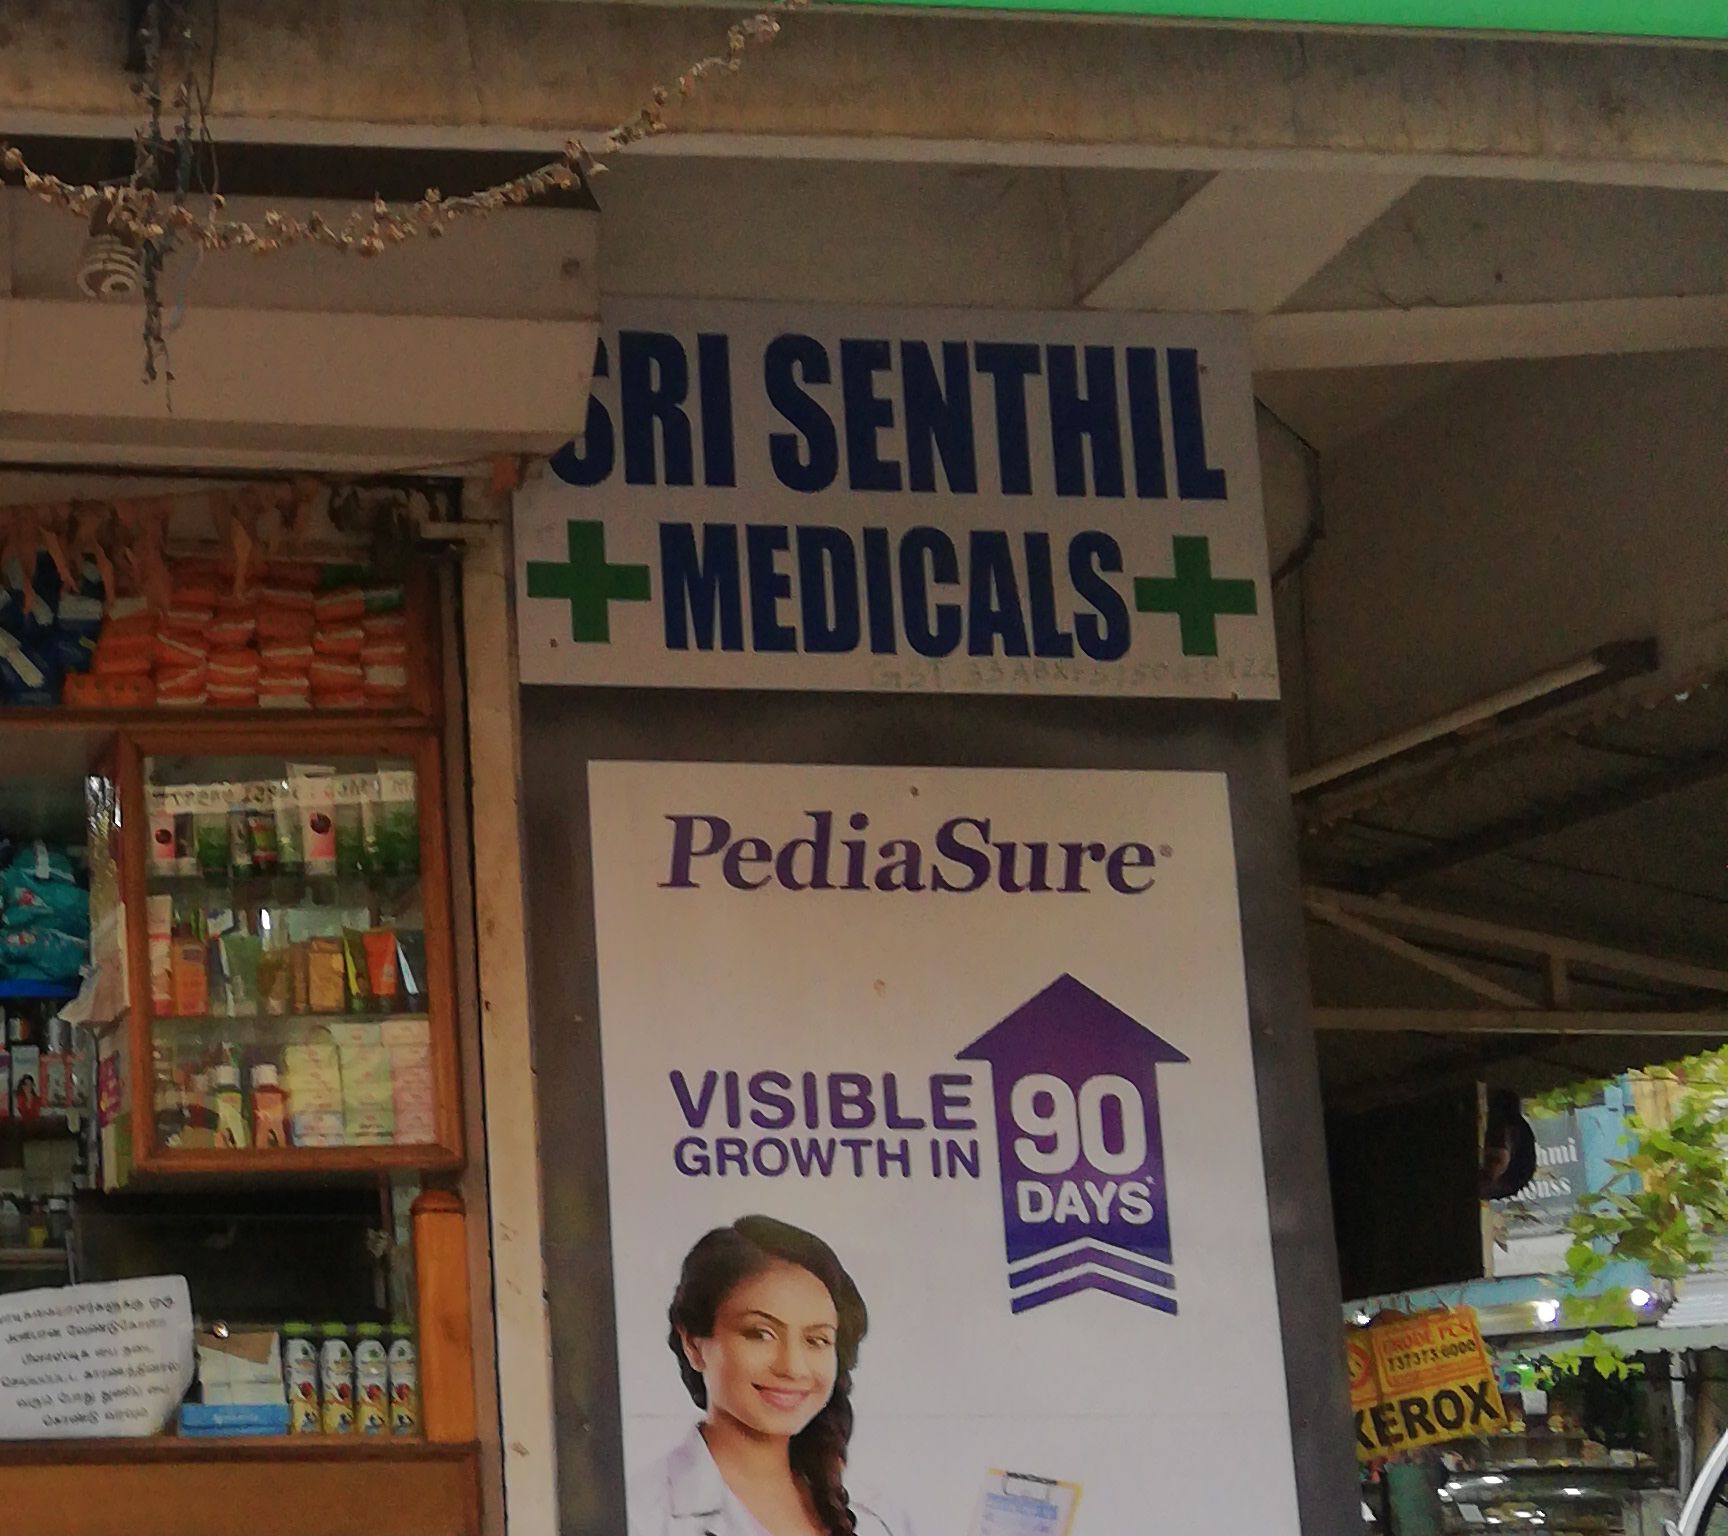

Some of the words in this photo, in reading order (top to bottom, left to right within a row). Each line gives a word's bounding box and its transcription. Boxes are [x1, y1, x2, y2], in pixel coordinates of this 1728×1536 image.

[763, 332, 1229, 500] SENTHIL
[659, 519, 1132, 662] MEDICALS
[656, 809, 1158, 896] PediaSure
[668, 1070, 982, 1133] VISIBLE
[1009, 1072, 1150, 1178] 90
[672, 1139, 913, 1180] GROWTH
[928, 1140, 983, 1181] IN
